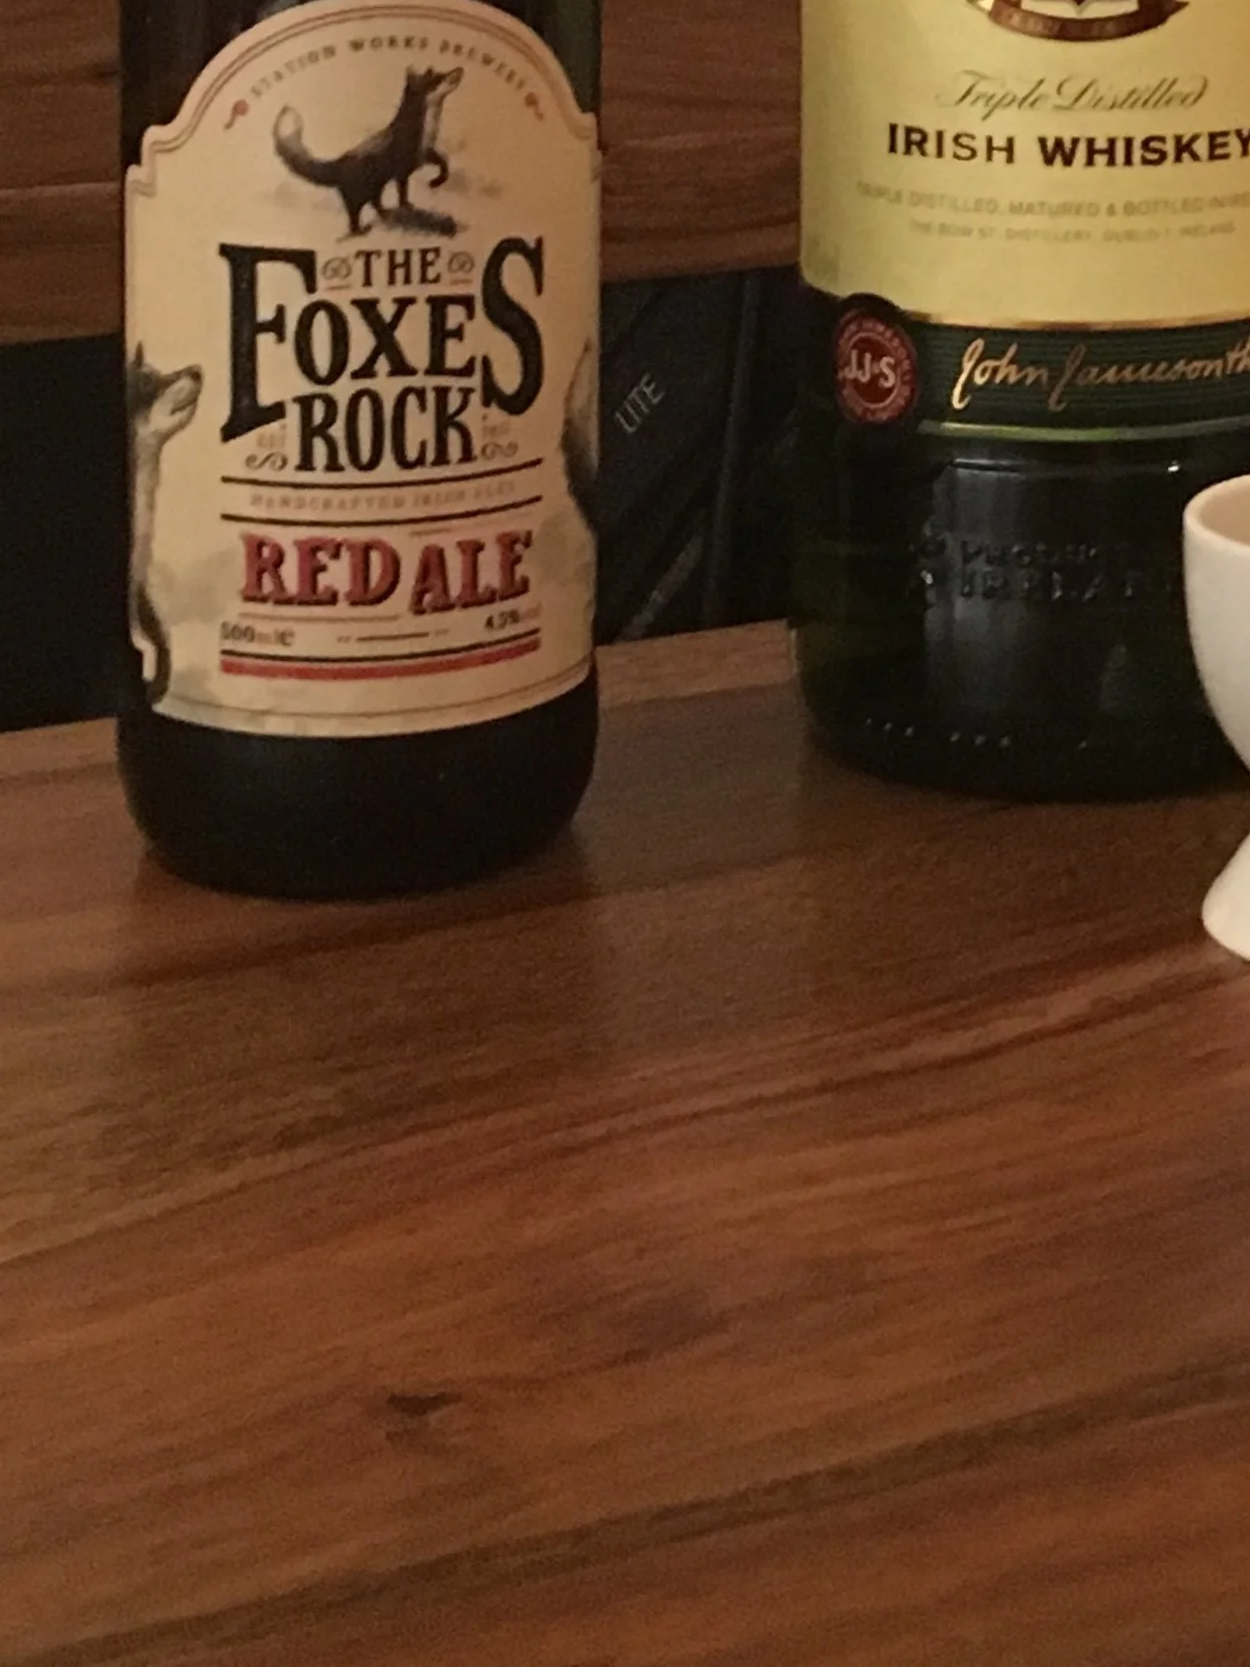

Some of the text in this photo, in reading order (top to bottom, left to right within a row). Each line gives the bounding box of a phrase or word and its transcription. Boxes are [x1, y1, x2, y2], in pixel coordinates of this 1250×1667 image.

[348, 36, 429, 52] WORKS
[935, 69, 1209, 122] Triple Distilled
[886, 122, 1016, 165] IRISH
[355, 248, 442, 287] THE
[218, 236, 545, 443] FOXES
[613, 371, 666, 434] LITE
[952, 338, 1049, 411] John
[291, 386, 477, 473] ROCK
[239, 529, 534, 615] RED ALE
